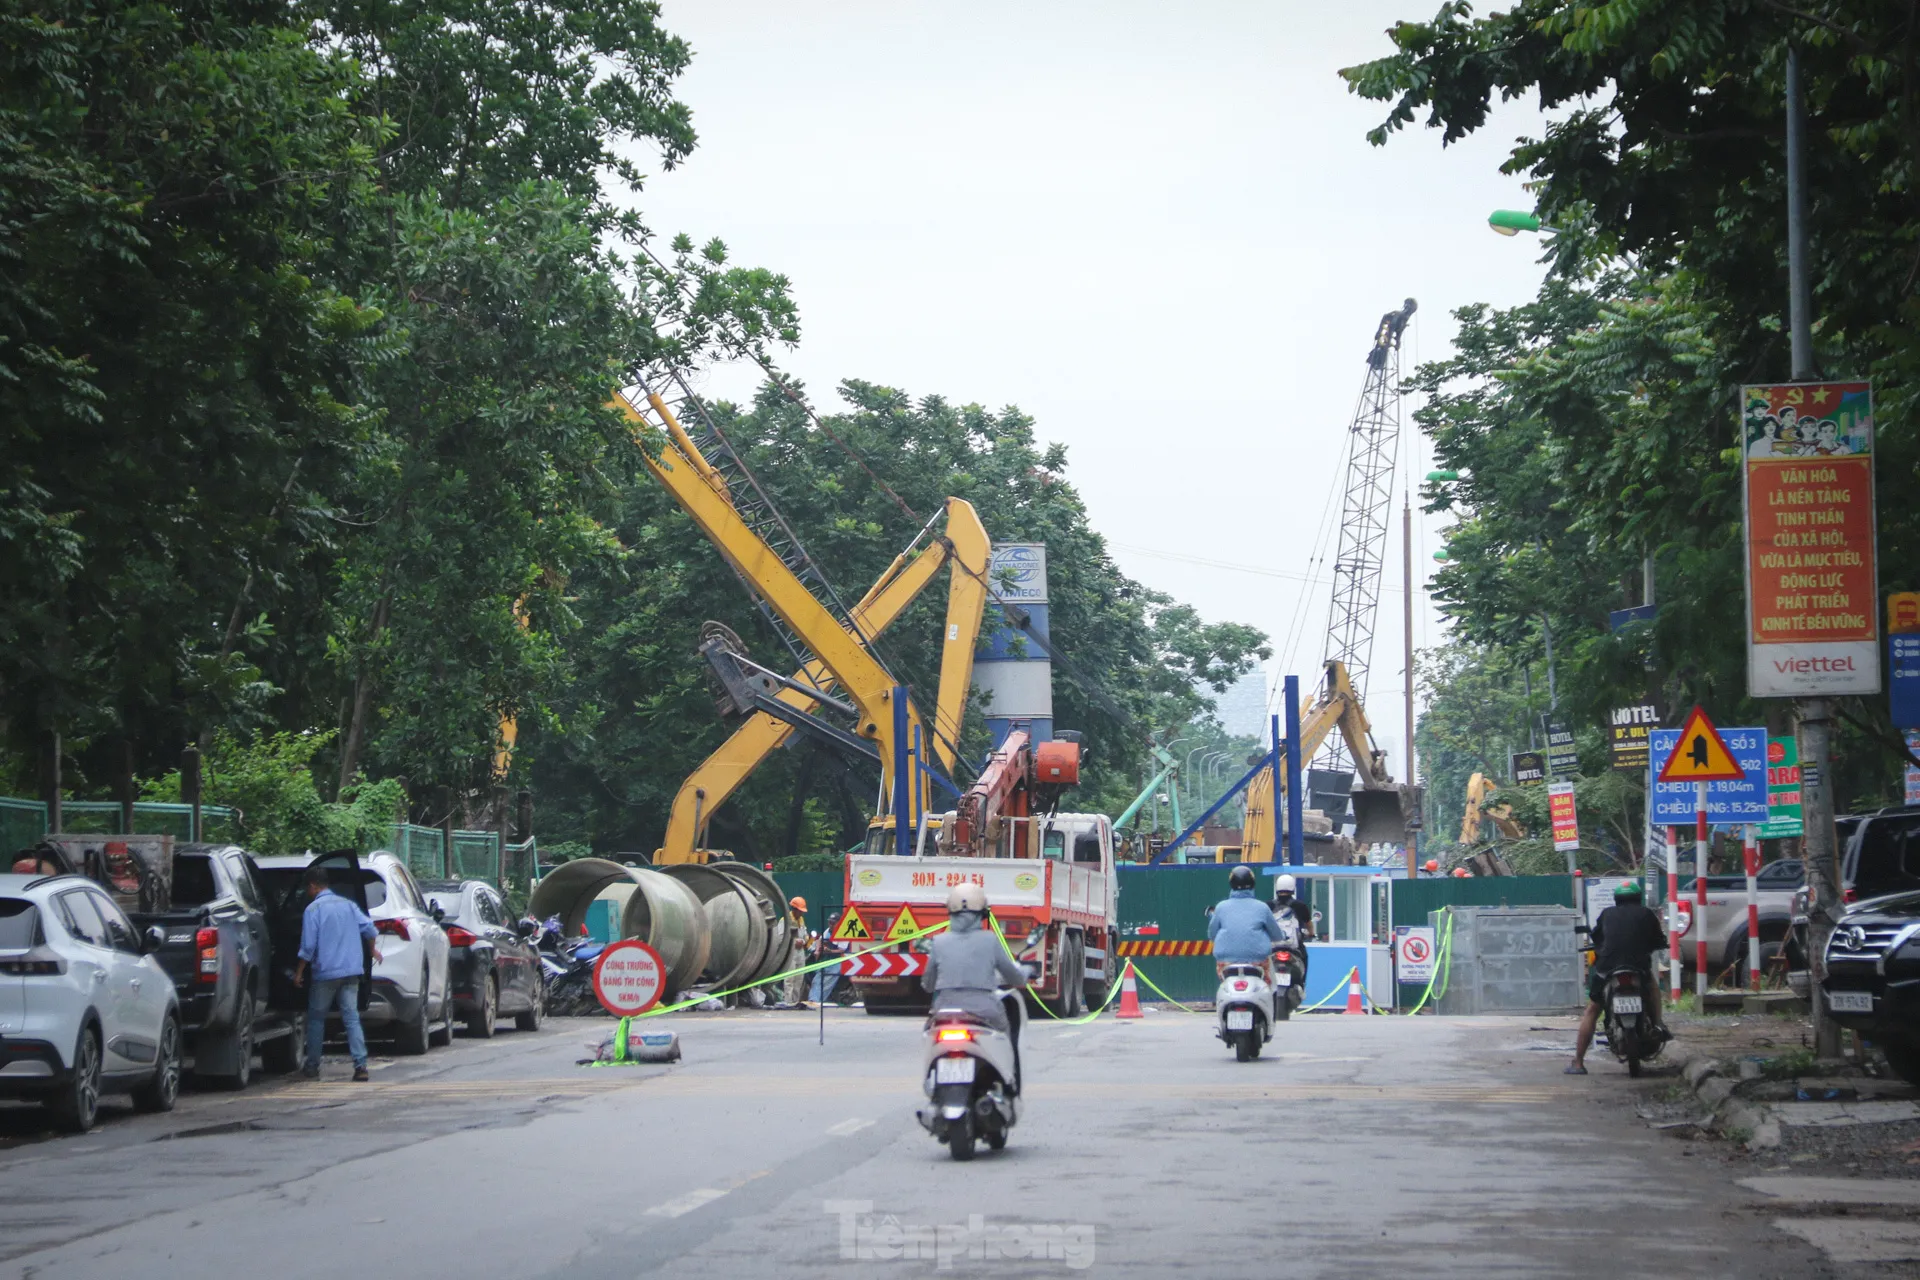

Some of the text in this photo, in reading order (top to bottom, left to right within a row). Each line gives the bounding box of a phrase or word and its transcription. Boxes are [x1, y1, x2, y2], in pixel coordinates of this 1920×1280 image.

[1781, 467, 1837, 483] VĂN HÓA
[1768, 489, 1785, 505] LÀ
[1776, 511, 1807, 526] TINH
[1773, 529, 1798, 547] CỦA
[1760, 552, 1785, 568] VỪA
[1787, 551, 1802, 567] LÀ
[1804, 553, 1832, 570] MỤC
[1780, 573, 1844, 592] ĐỘNG LỰC
[1776, 593, 1808, 609] PHÁT
[1762, 616, 1790, 631] KINH
[1773, 656, 1856, 673] viettel
[1612, 705, 1660, 725] HOTEL
[1731, 733, 1747, 750] SỐ
[1749, 739, 1756, 749] 3
[1517, 768, 1543, 780] HOTEL
[1716, 781, 1754, 793] 19,04m
[1732, 802, 1768, 813] 15,25m
[912, 872, 935, 887] 30M
[624, 977, 635, 987] THI
